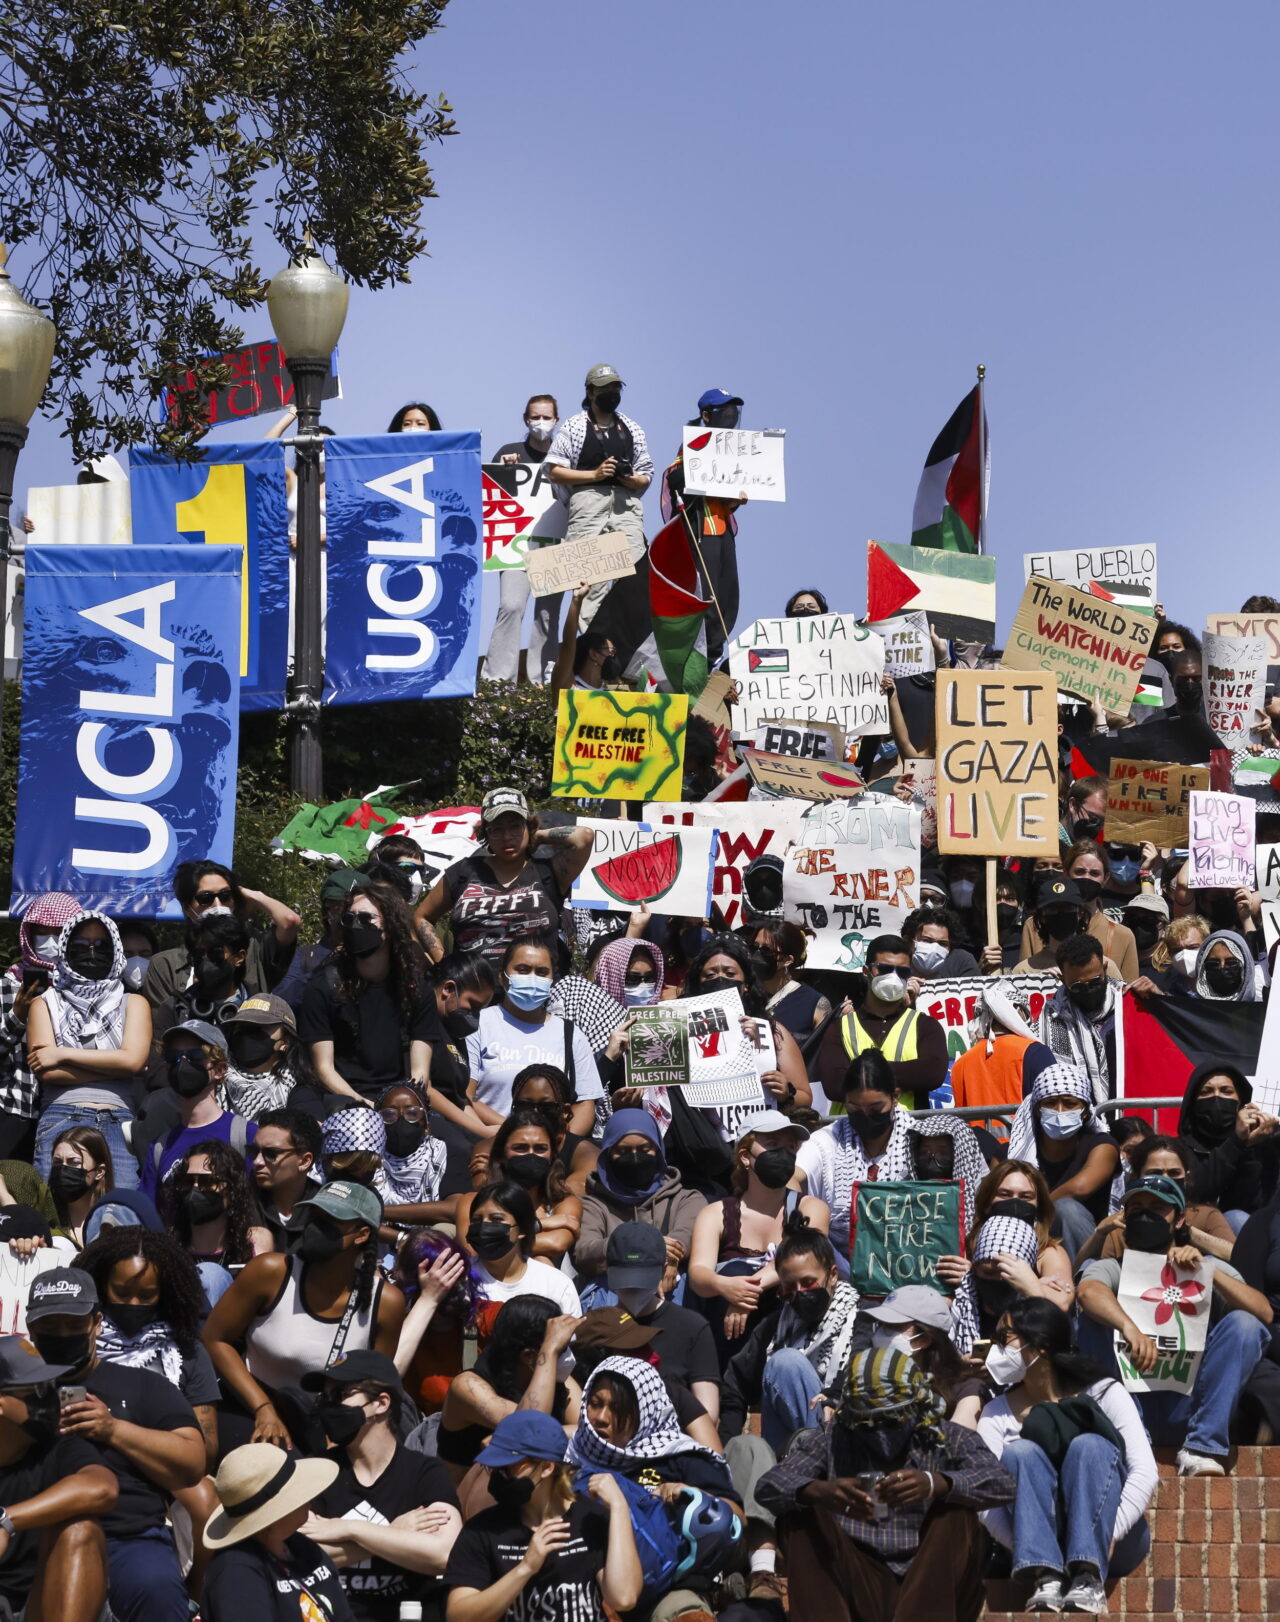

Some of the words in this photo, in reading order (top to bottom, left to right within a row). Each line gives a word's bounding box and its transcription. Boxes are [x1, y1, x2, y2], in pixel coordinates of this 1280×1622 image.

[715, 431, 761, 457] FREE
[689, 457, 777, 489] Palestine
[364, 457, 437, 672] UCLA
[553, 539, 600, 564] FREE
[1076, 549, 1155, 579] PUEBLO
[530, 550, 634, 590] PALESTINE
[1031, 581, 1064, 611] The
[1067, 597, 1127, 636] WORLD
[1128, 621, 1151, 646] IS
[736, 615, 871, 649] LATINAS
[891, 630, 922, 646] FREE
[1036, 613, 1148, 672] WATCHING
[819, 649, 833, 670] 4
[885, 646, 924, 664] STINE
[1016, 632, 1100, 674] Claremont
[1107, 667, 1127, 685] in
[1239, 668, 1258, 681] THE
[945, 680, 1044, 728] LET
[1209, 683, 1254, 699] RIVER
[71, 580, 176, 871] UCLA
[578, 724, 609, 741] FREE
[612, 727, 646, 744] FREE
[1210, 712, 1243, 732] SEA
[574, 741, 646, 763] PALESTINE
[941, 739, 1057, 785] GAZA
[755, 758, 812, 776] FREE
[1114, 763, 1137, 780] NO
[1142, 769, 1169, 785] ONE
[1181, 774, 1197, 787] IS
[944, 790, 1049, 842] LIVE
[1108, 797, 1155, 814] UNTIL
[1165, 805, 1184, 817] WE
[1193, 794, 1241, 830] Long
[801, 802, 917, 851] FROM
[1193, 820, 1249, 848] Live
[594, 829, 681, 857] DIVEST
[792, 848, 837, 876] THE
[830, 865, 916, 909] RIVER
[461, 890, 542, 919] TIFFT
[795, 902, 829, 930] TO
[833, 902, 882, 931] THE
[631, 1070, 686, 1083] PALESTINE
[865, 1191, 948, 1223] CEASE
[883, 1221, 935, 1248] FIRE
[867, 1251, 941, 1280] NOW
